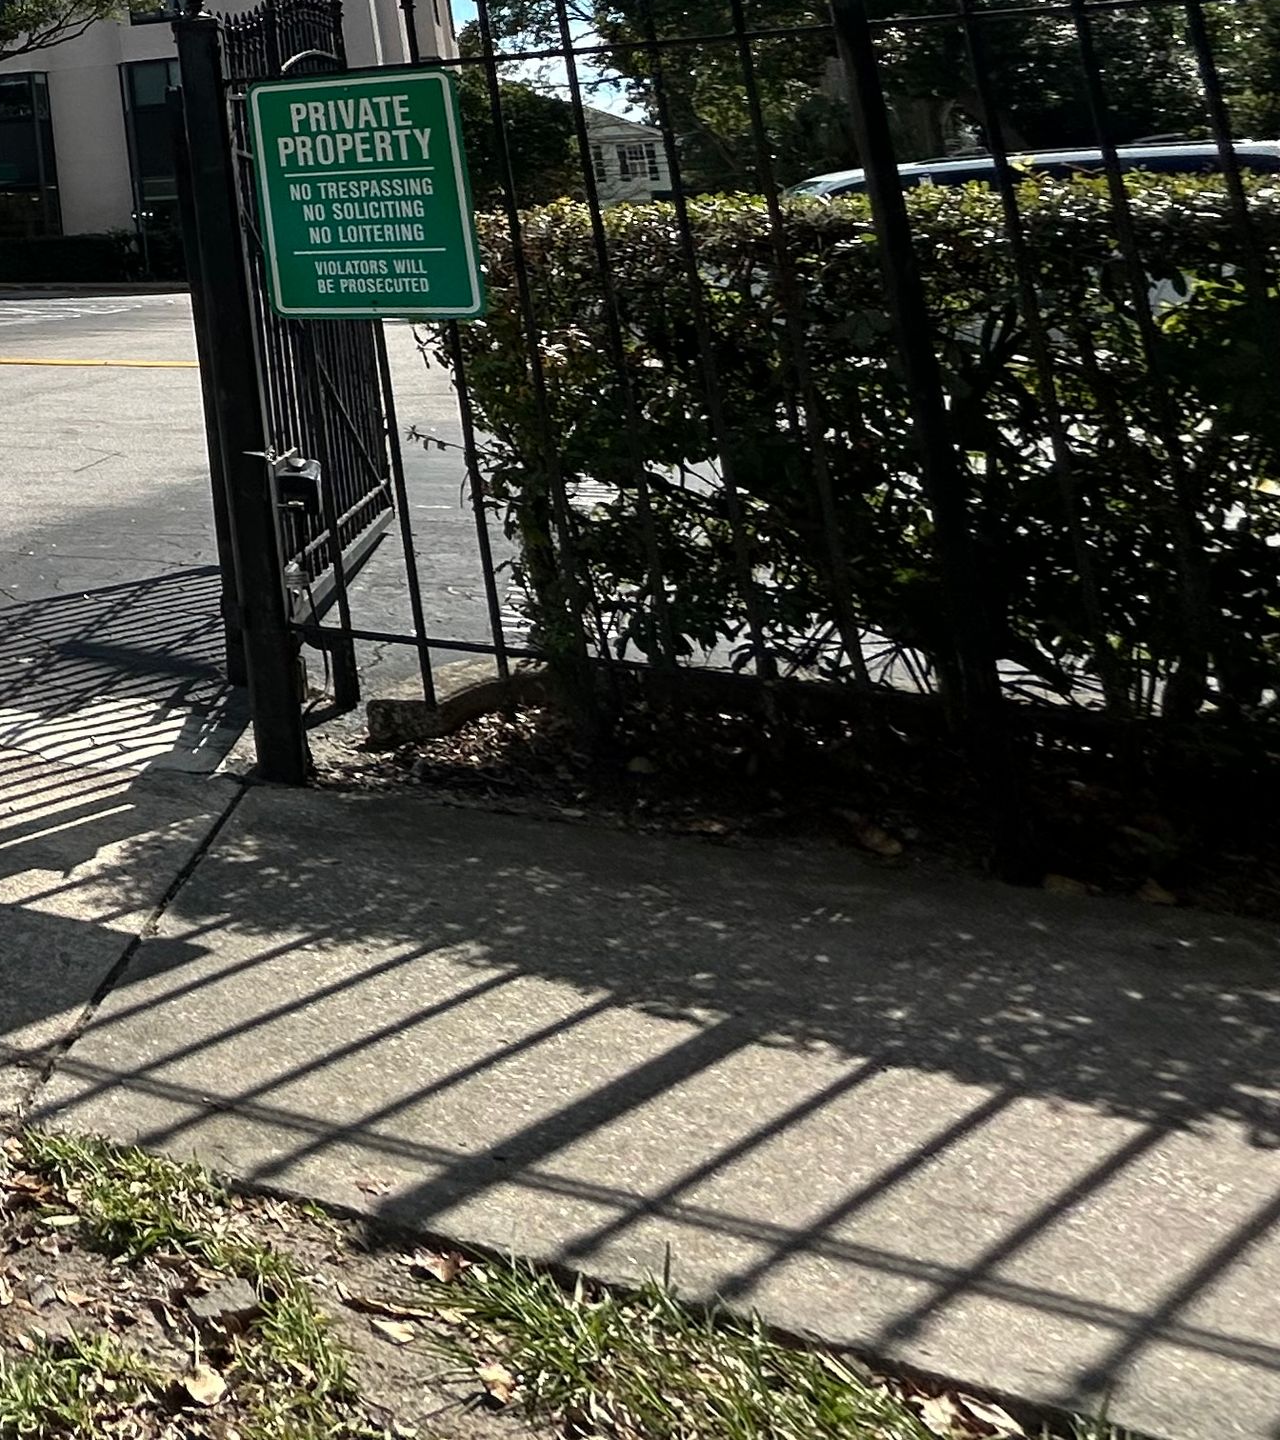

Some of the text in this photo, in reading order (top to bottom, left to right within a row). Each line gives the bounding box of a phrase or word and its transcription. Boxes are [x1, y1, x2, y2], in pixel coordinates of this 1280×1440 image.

[290, 95, 412, 133] PRIVATE
[278, 128, 431, 167] PROPERTY
[290, 178, 433, 201] NO TRESPASSING
[303, 200, 424, 221] NO SOLICITING
[309, 224, 424, 244] NO LOITERING
[315, 259, 427, 276] VIOLATORS WILL
[317, 278, 429, 293] BE PROSECUTED
